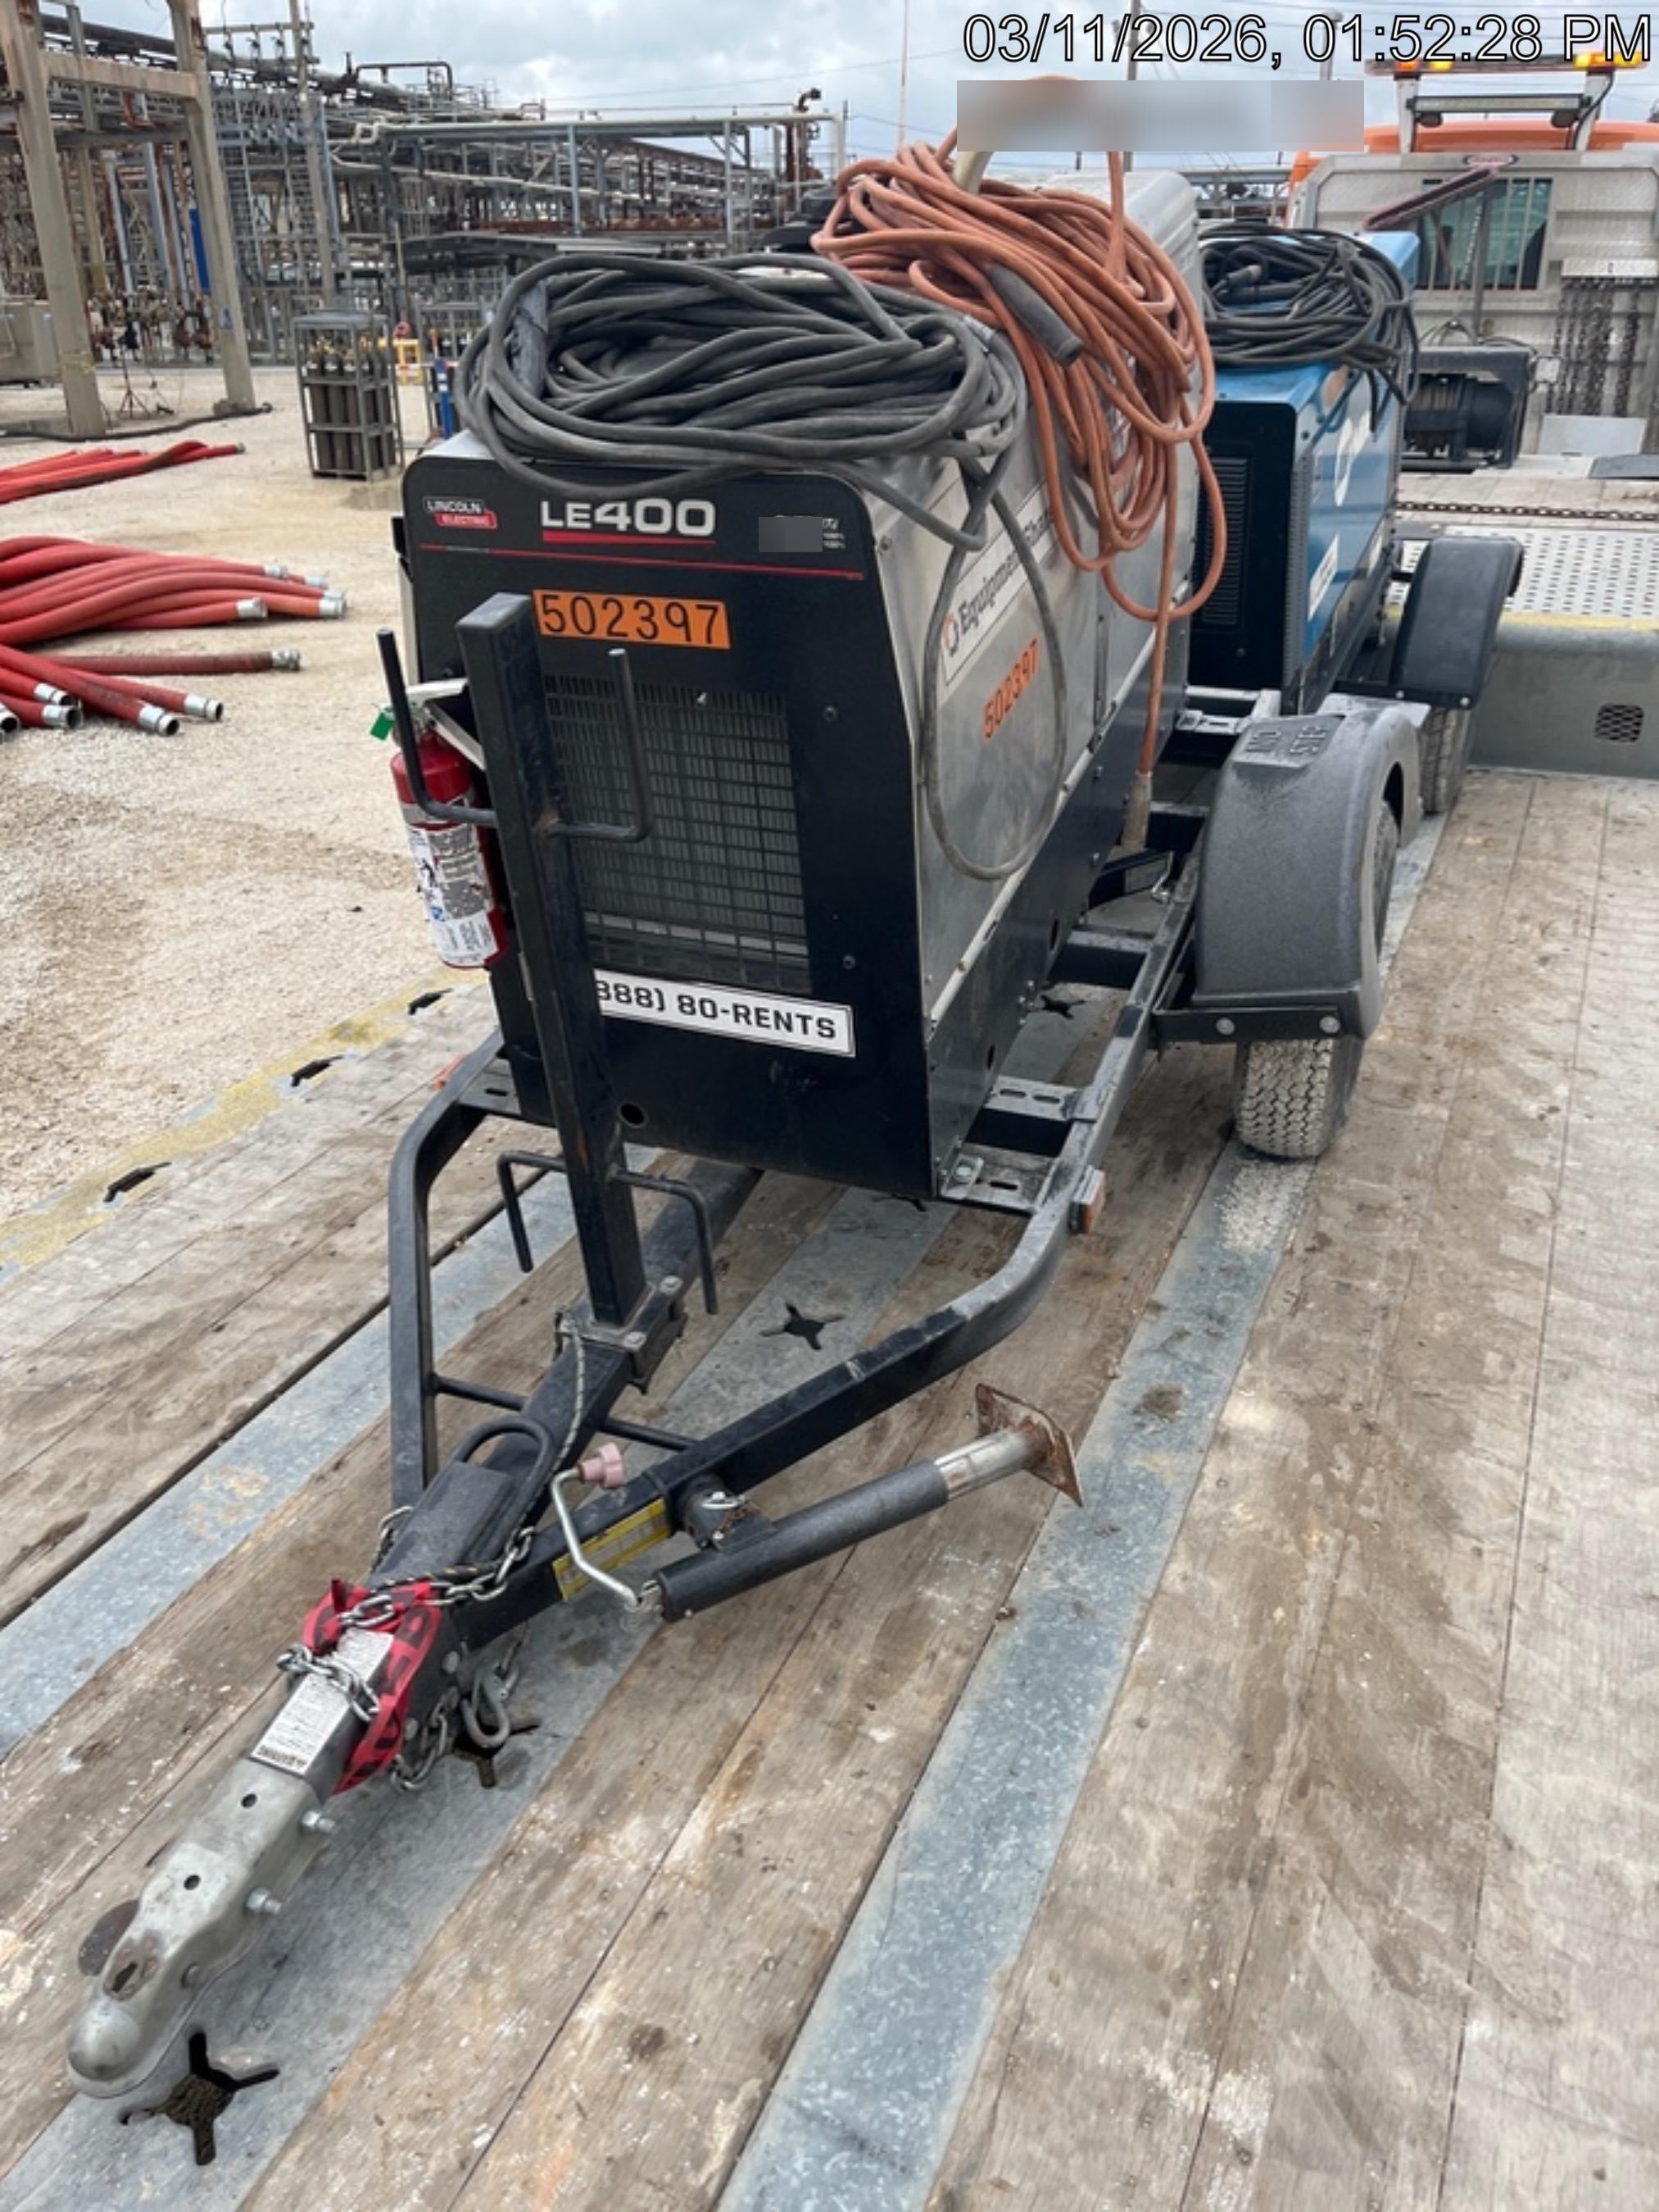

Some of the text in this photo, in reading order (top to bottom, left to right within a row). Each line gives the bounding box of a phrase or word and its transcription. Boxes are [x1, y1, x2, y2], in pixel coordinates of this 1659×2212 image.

[426, 500, 483, 514] LINCOLN
[541, 497, 716, 537] LE400
[540, 594, 721, 645] 502397
[678, 994, 837, 1040] 80-RENTS
